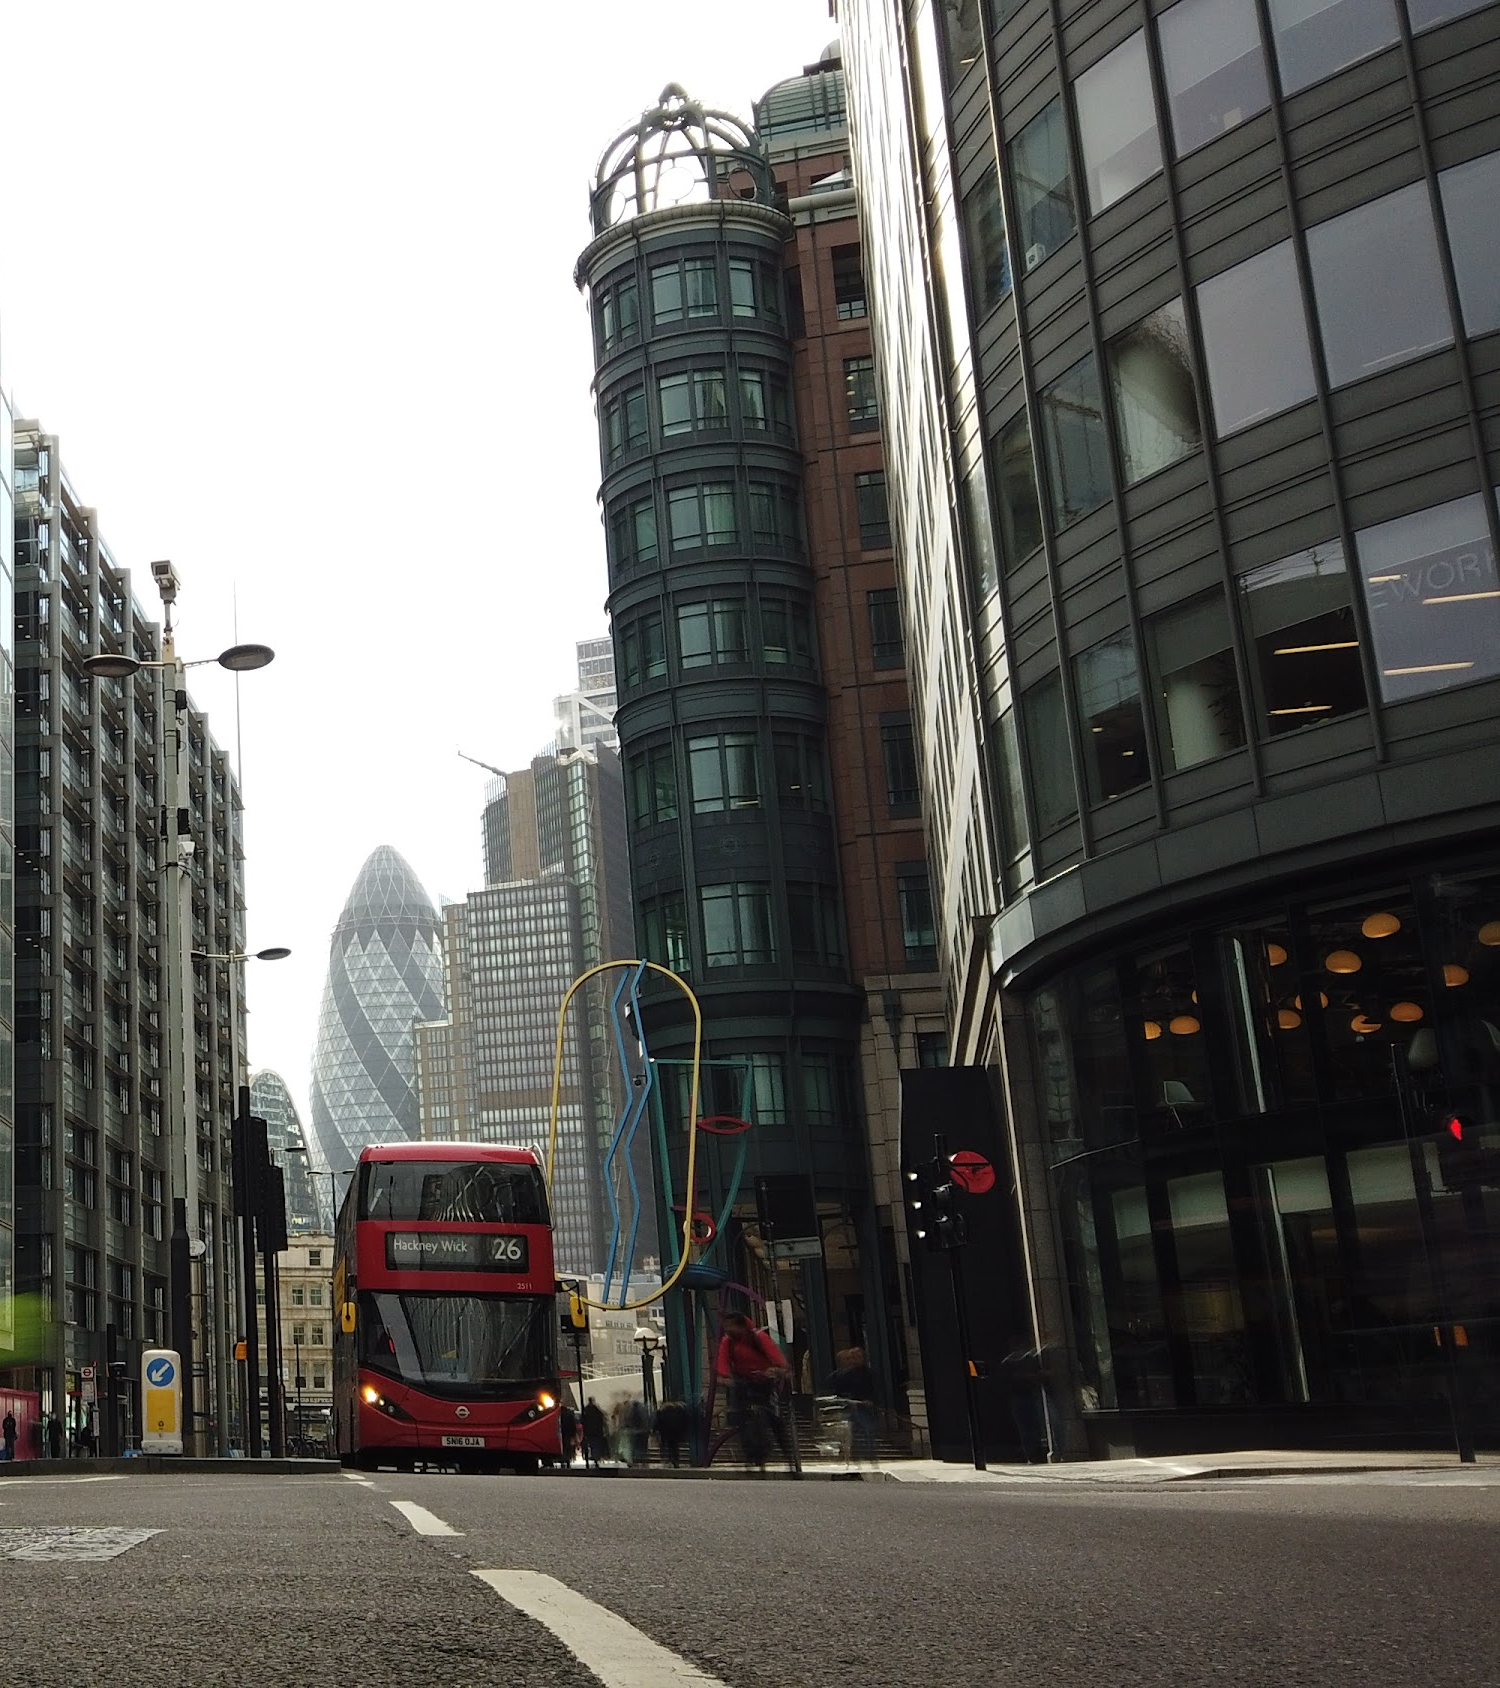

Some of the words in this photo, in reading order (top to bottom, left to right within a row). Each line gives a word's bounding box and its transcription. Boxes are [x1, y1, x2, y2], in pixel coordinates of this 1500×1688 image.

[393, 1239, 439, 1254] Hackney
[441, 1240, 468, 1253] Wick
[493, 1239, 521, 1260] 26
[446, 1437, 464, 1445] SN16
[465, 1438, 480, 1446] OJA
